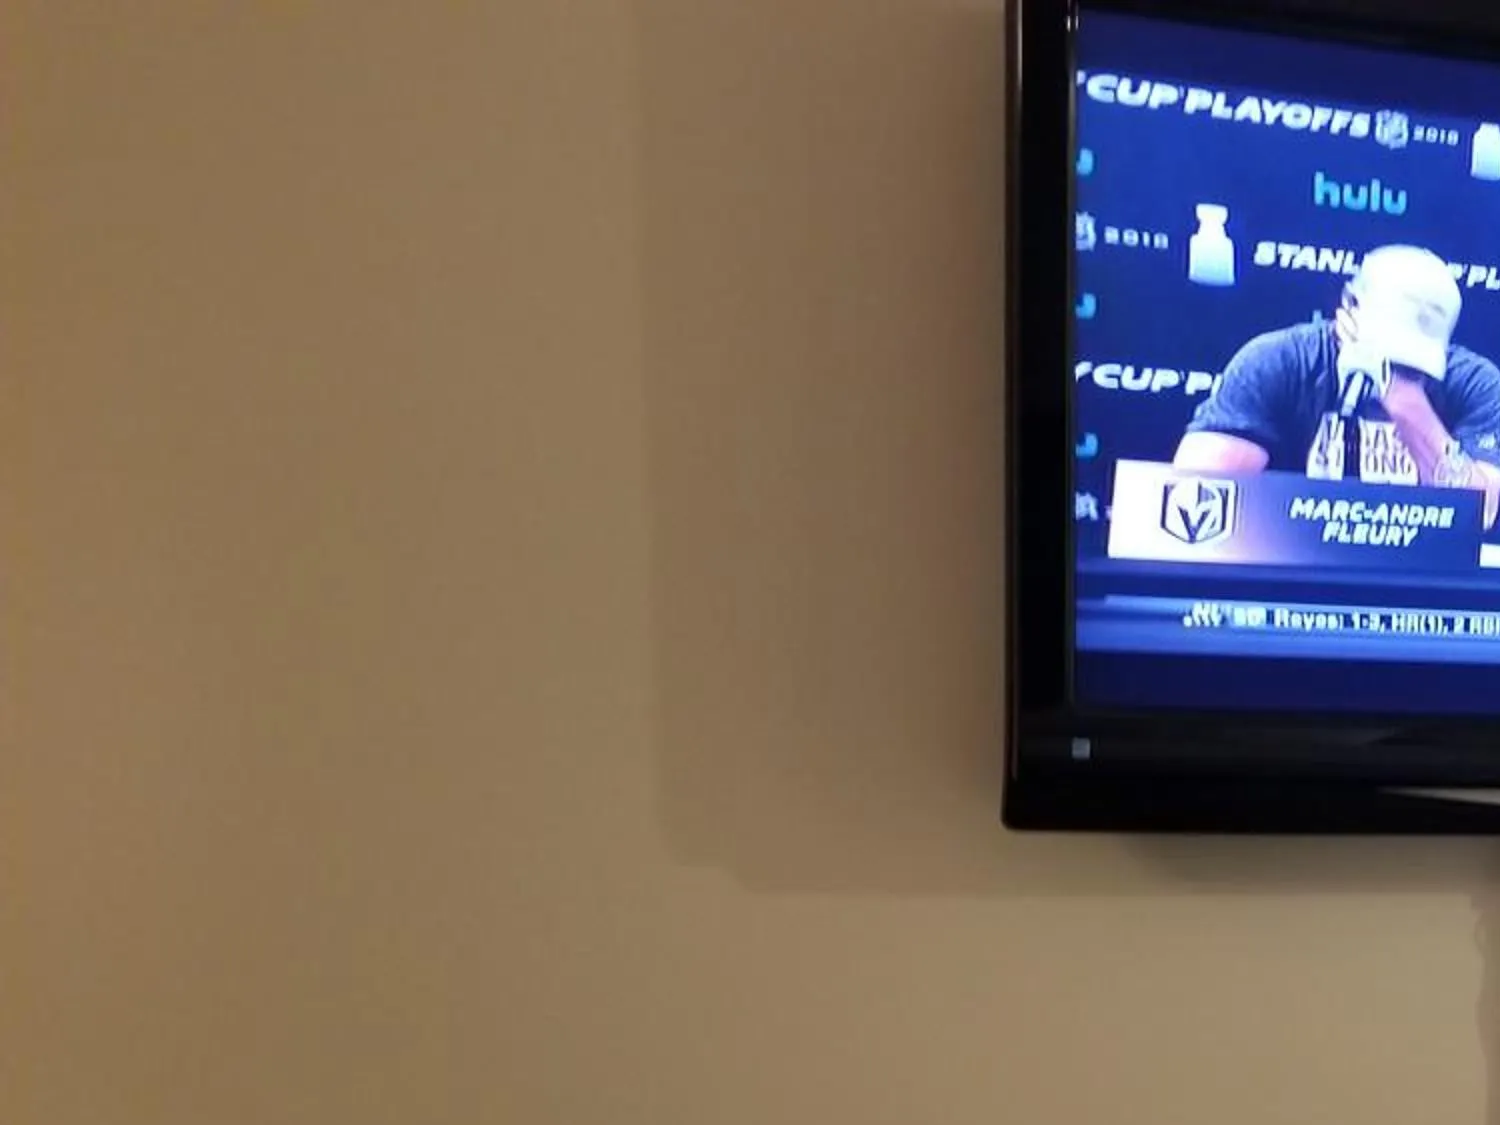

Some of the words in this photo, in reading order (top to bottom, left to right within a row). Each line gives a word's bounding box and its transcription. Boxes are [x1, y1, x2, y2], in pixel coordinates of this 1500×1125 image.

[1086, 73, 1179, 110] CUP
[1184, 88, 1371, 139] PLAYOFFS
[1314, 170, 1407, 215] hulu
[1253, 240, 1359, 278] STANL
[1092, 362, 1181, 394] CUP
[1289, 496, 1456, 529] MARC-ANDRE
[1322, 520, 1420, 548] FLEURY
